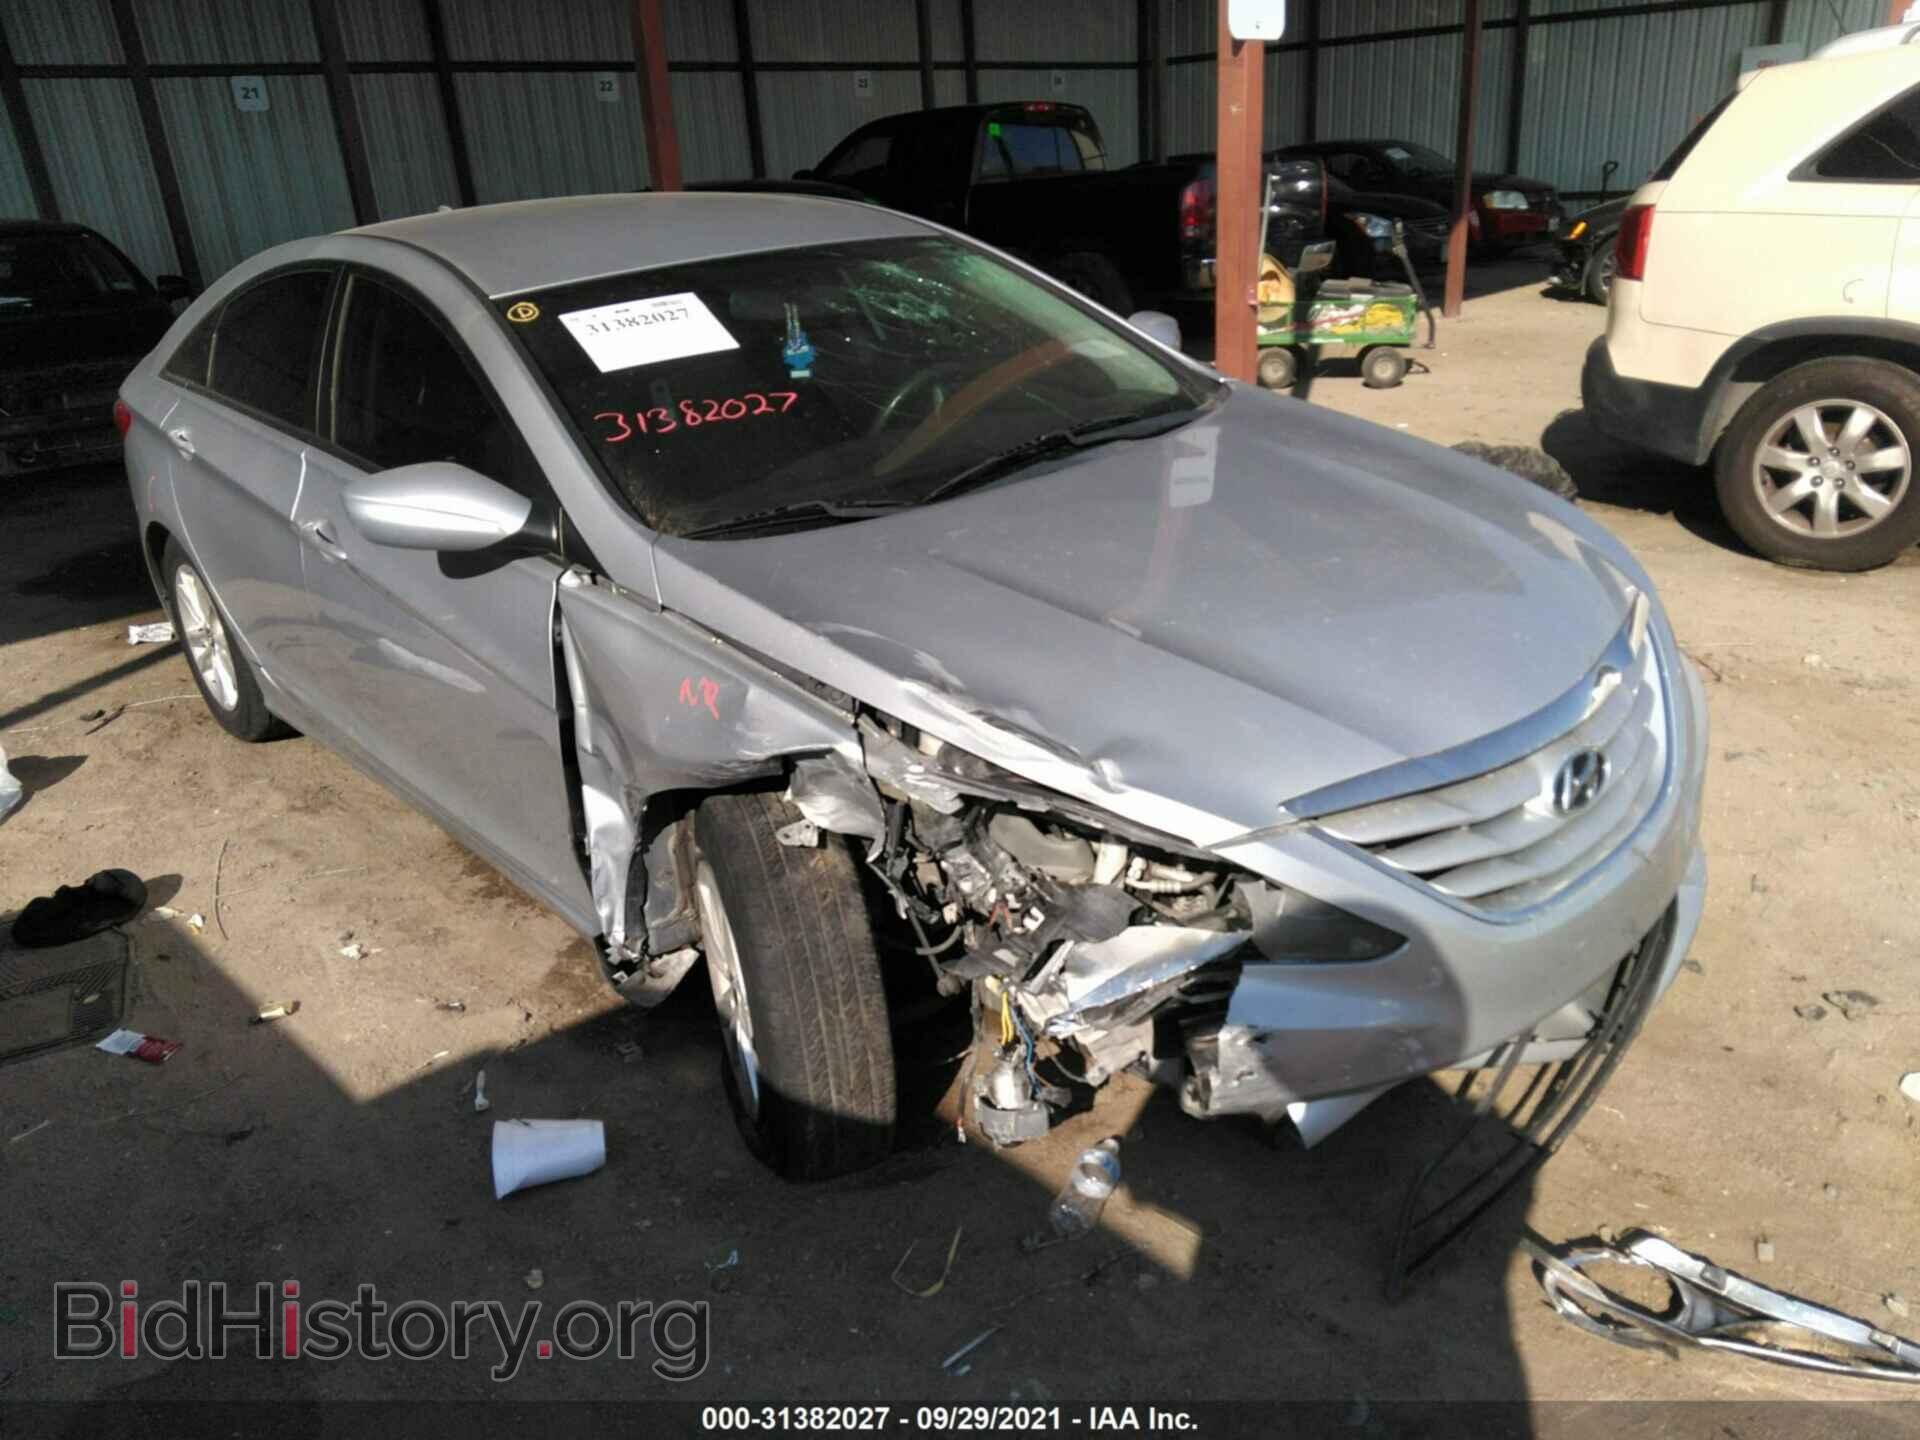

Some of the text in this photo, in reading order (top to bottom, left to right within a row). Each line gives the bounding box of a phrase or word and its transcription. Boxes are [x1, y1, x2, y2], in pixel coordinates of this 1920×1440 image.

[240, 87, 258, 99] 21
[586, 306, 690, 335] 31382027
[594, 392, 797, 441] 31382027
